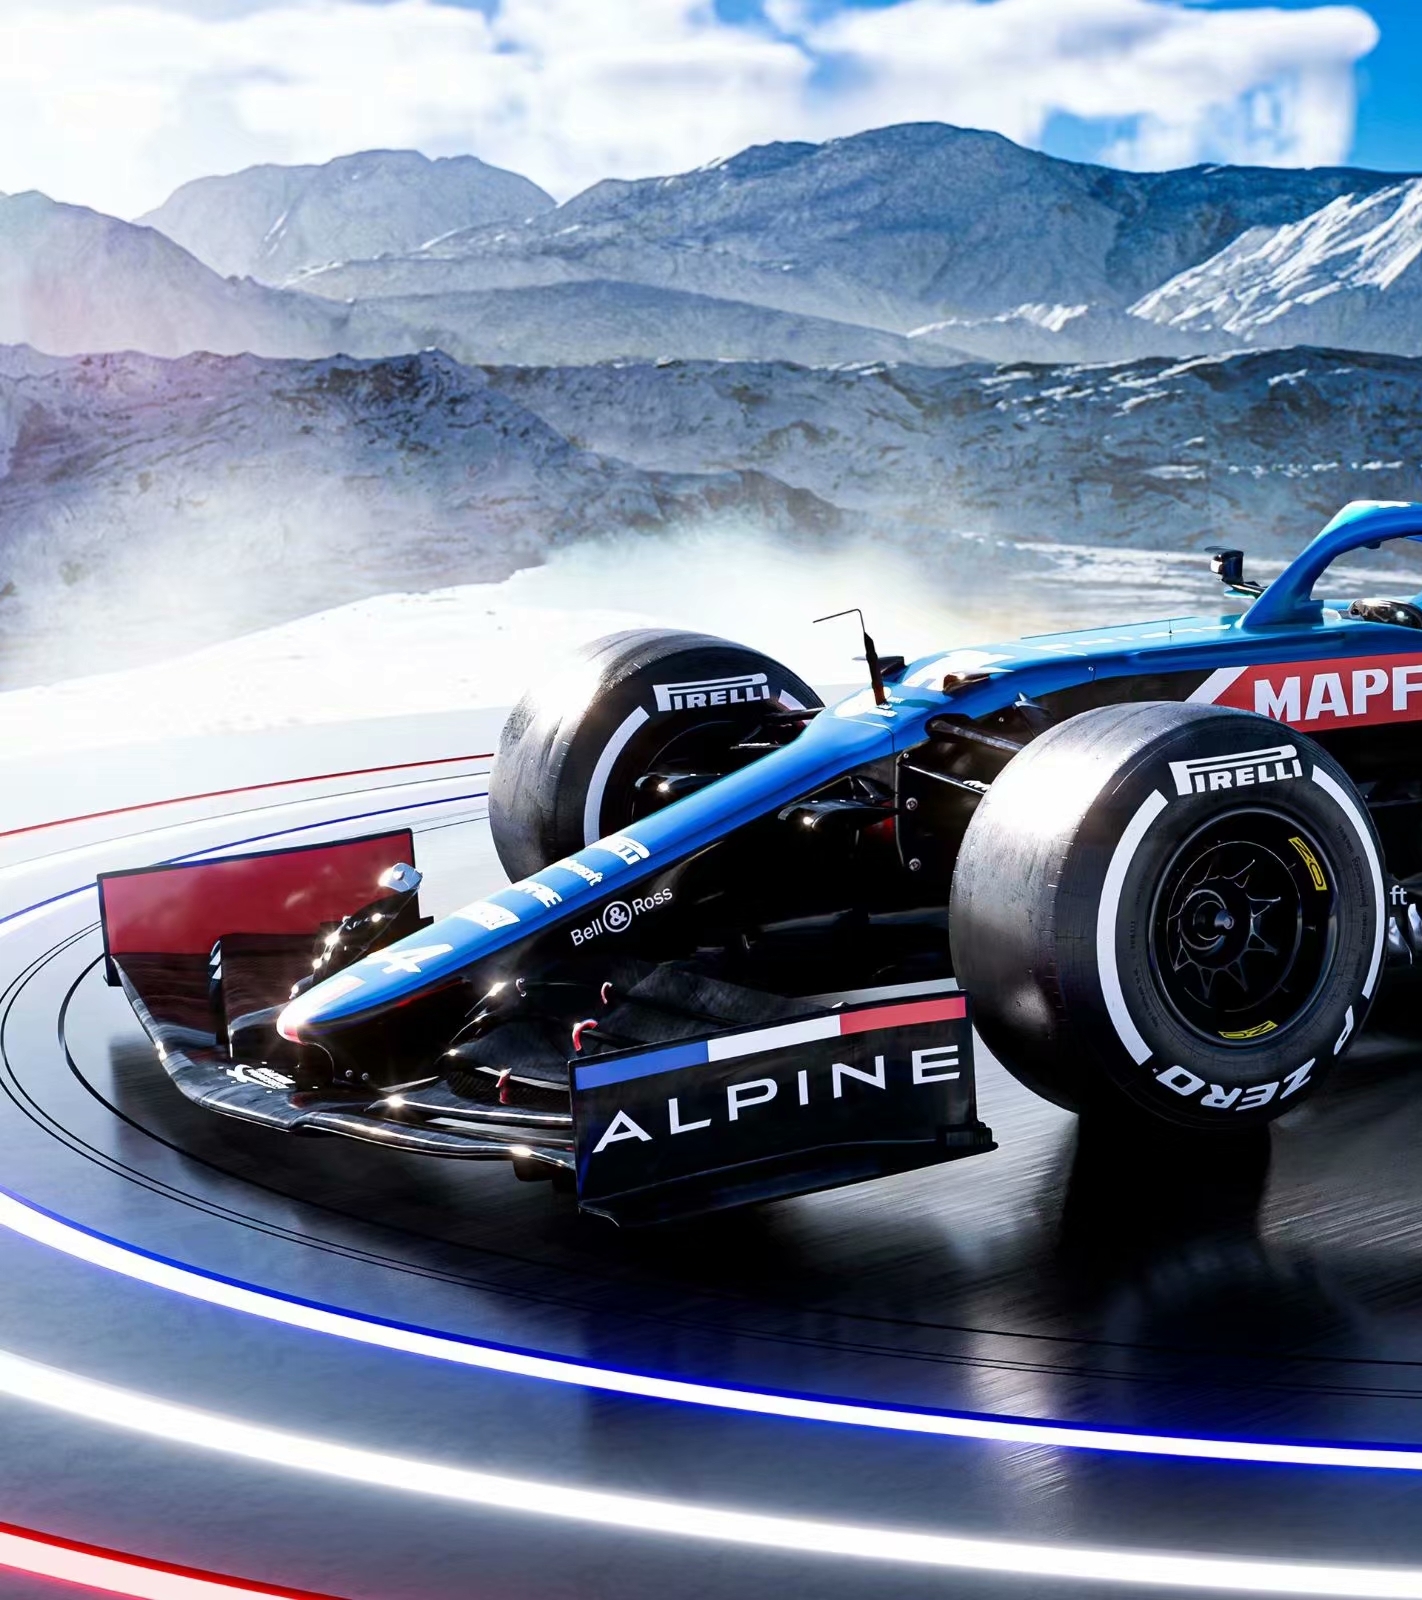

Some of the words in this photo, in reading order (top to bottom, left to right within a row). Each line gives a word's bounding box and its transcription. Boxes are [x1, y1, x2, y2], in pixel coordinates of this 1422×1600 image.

[652, 672, 770, 712] PIRELLI
[1168, 744, 1303, 796] PIRELLI
[570, 919, 603, 946] Bell
[632, 888, 673, 915] Ross
[592, 1045, 962, 1154] ALPINE
[1155, 1057, 1316, 1112] ZERO
